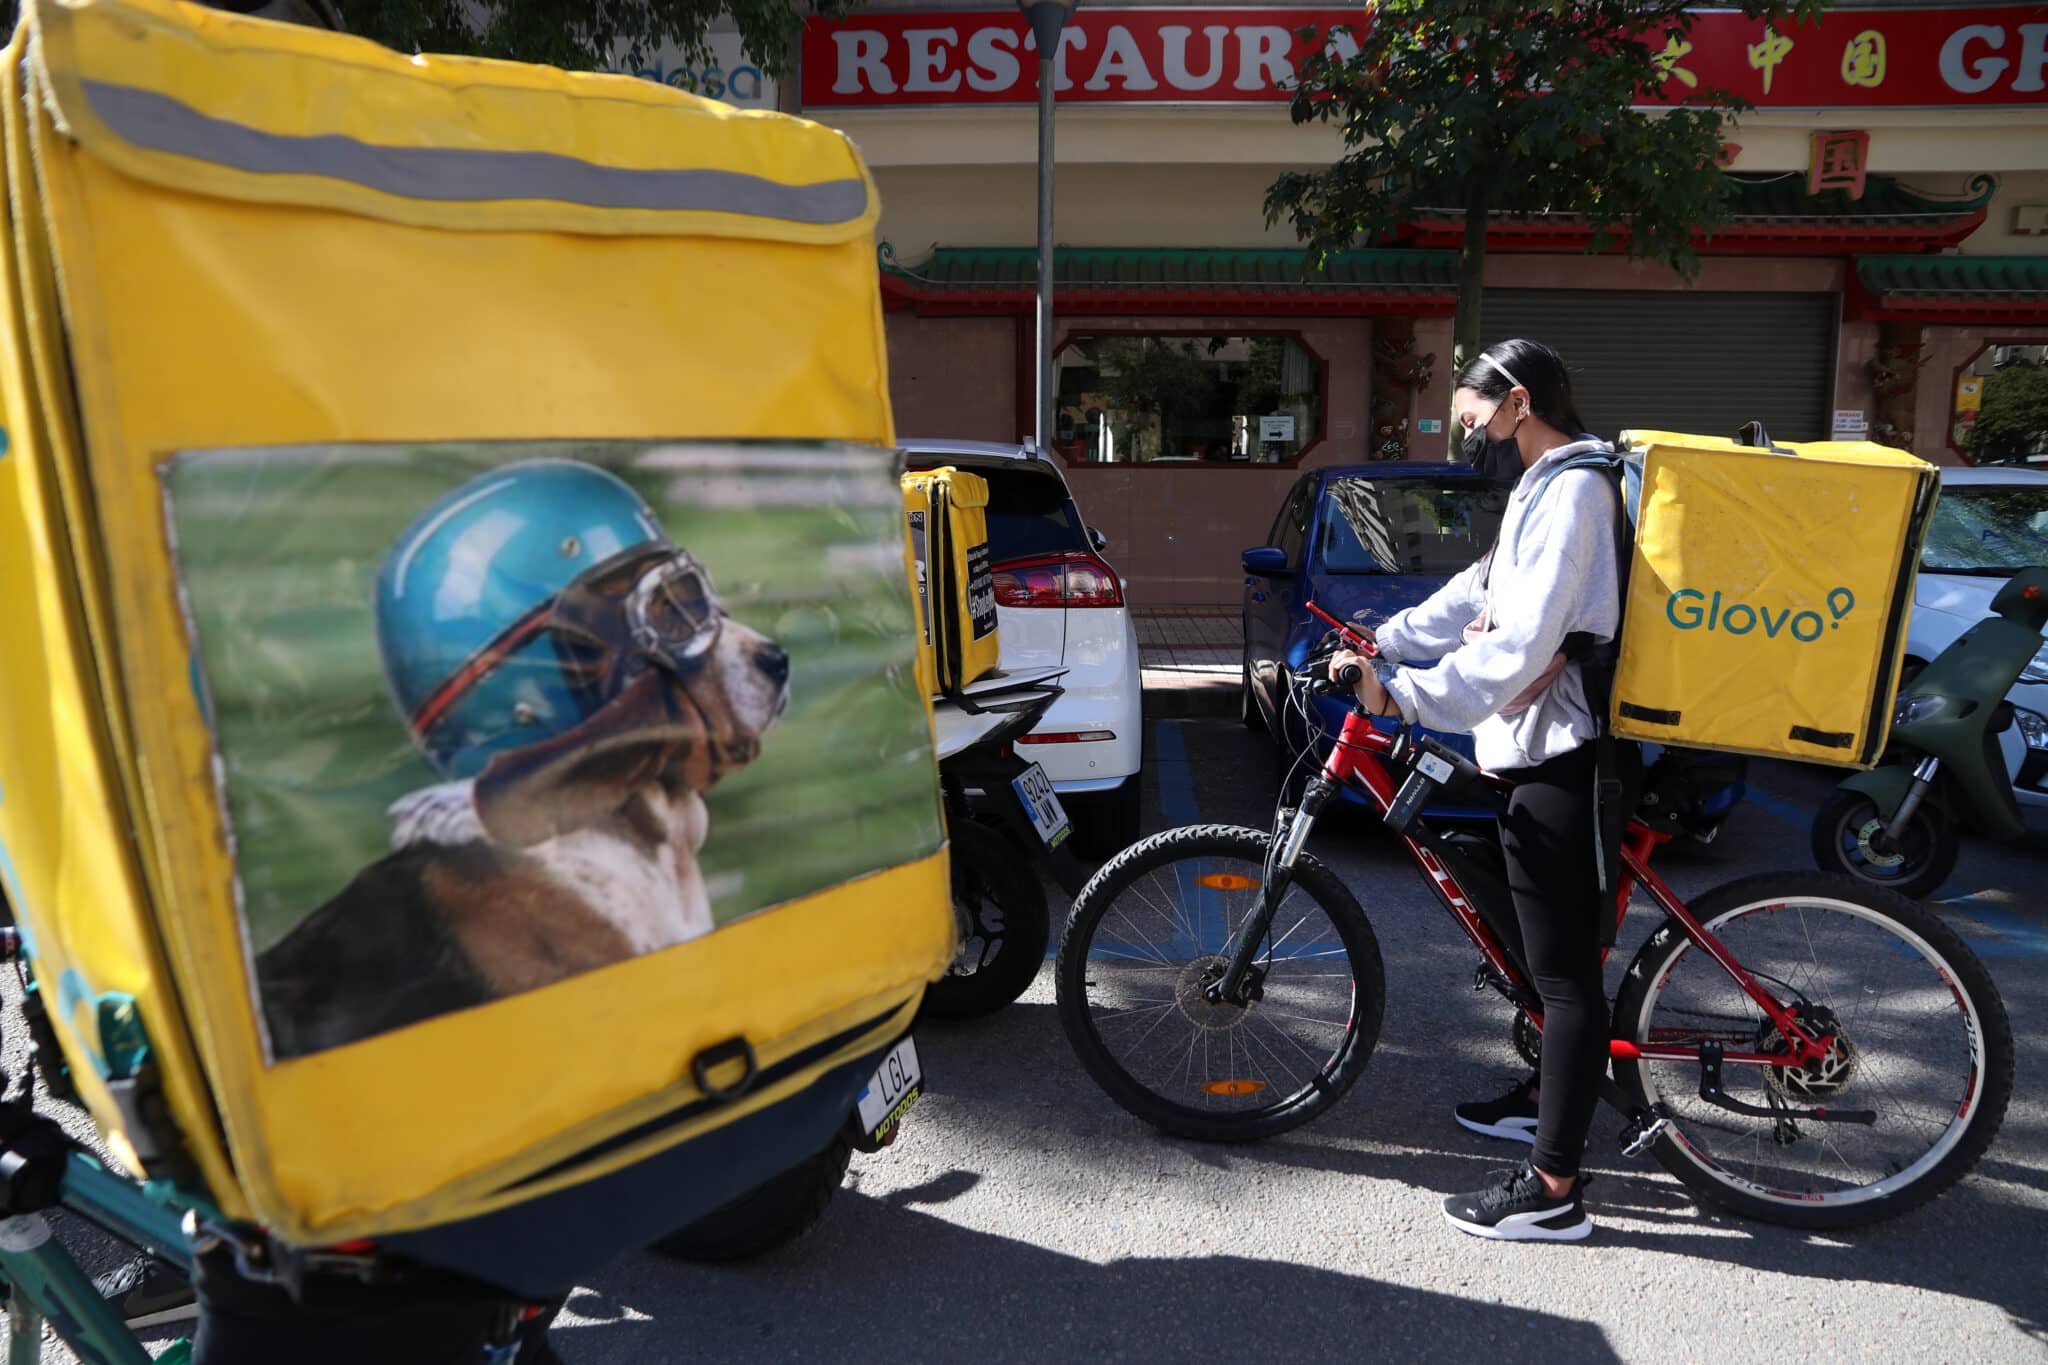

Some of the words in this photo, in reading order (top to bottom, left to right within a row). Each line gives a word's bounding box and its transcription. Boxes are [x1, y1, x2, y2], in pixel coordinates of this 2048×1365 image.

[1666, 588, 1824, 642] Glovo
[1022, 770, 1050, 804] 9242
[877, 1050, 913, 1106] LGL
[875, 1087, 919, 1143] MOTODOS
